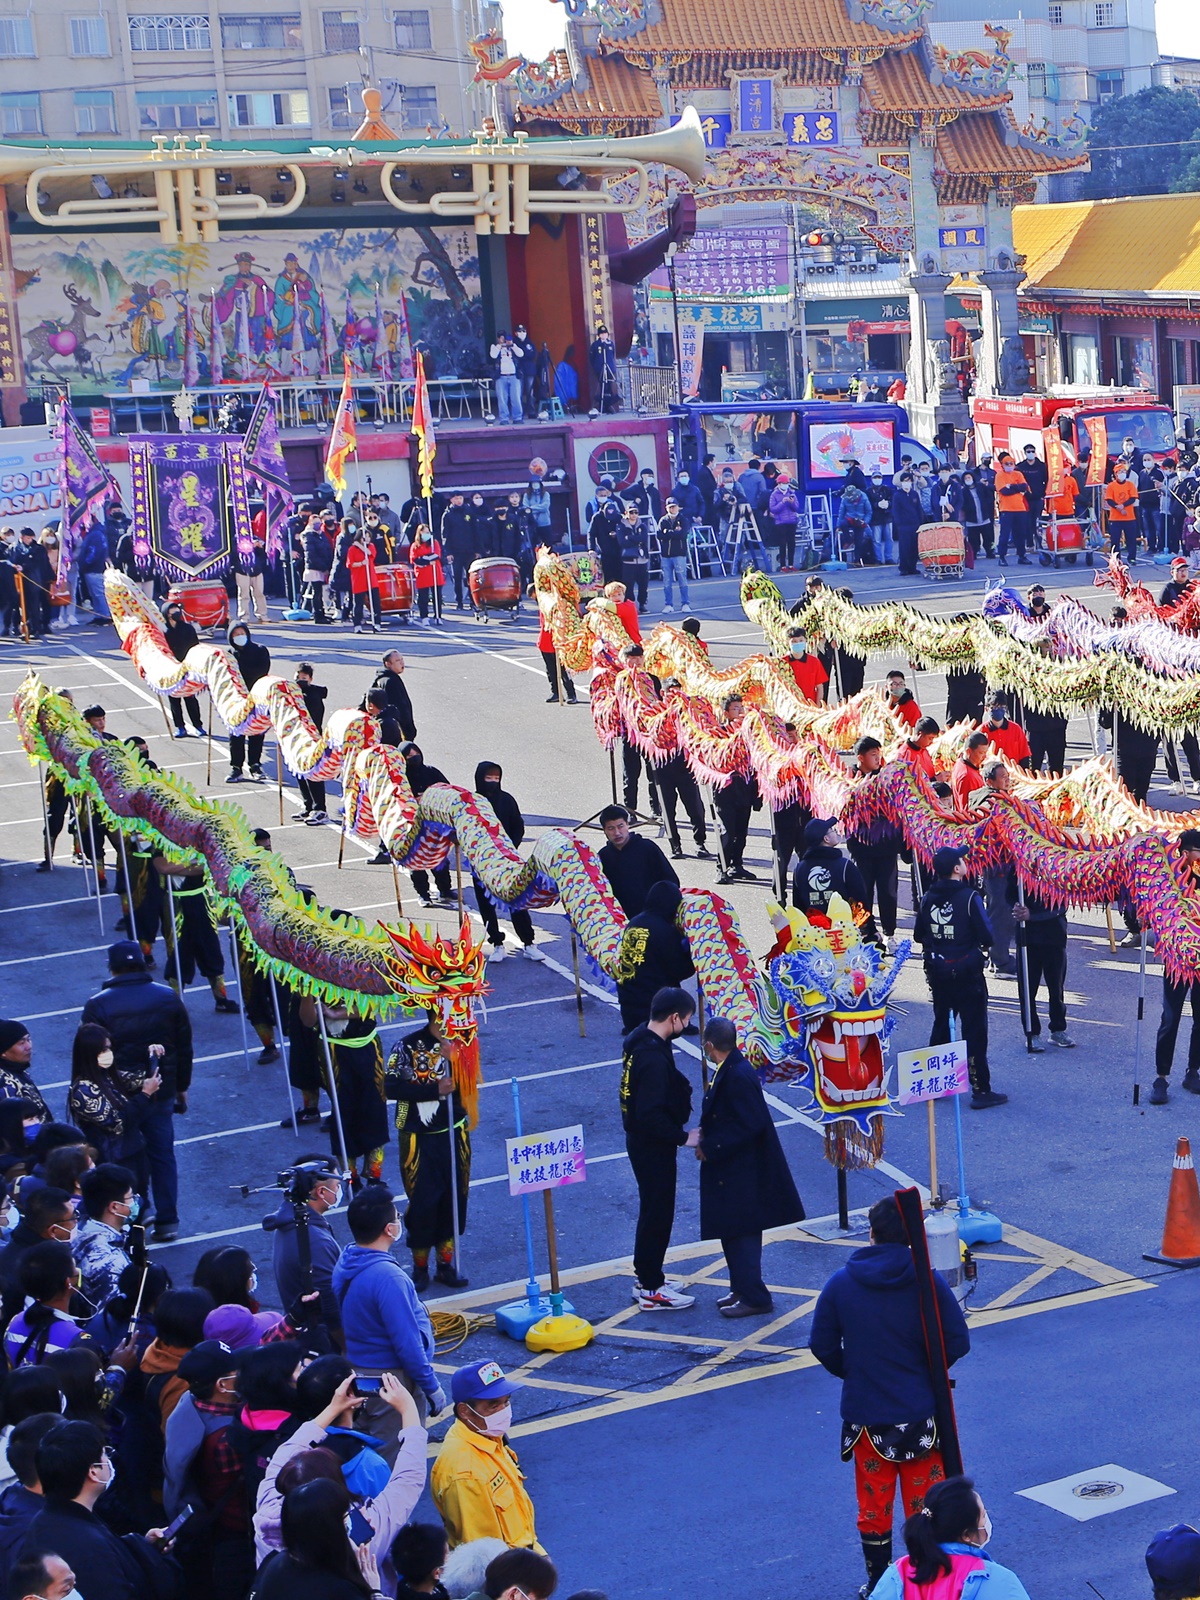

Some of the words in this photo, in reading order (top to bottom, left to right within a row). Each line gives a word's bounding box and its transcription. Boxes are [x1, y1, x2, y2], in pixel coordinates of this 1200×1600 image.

[749, 83, 762, 129] 玉清宮
[164, 444, 209, 459] 苗栗
[1, 473, 28, 493] 5G
[0, 491, 48, 516] ASIA
[577, 557, 592, 583] 尚好
[909, 1073, 960, 1097] 祥龍隊
[510, 1136, 582, 1165] 臺中祥瑞創意
[518, 1159, 577, 1184] 競技龍隊
